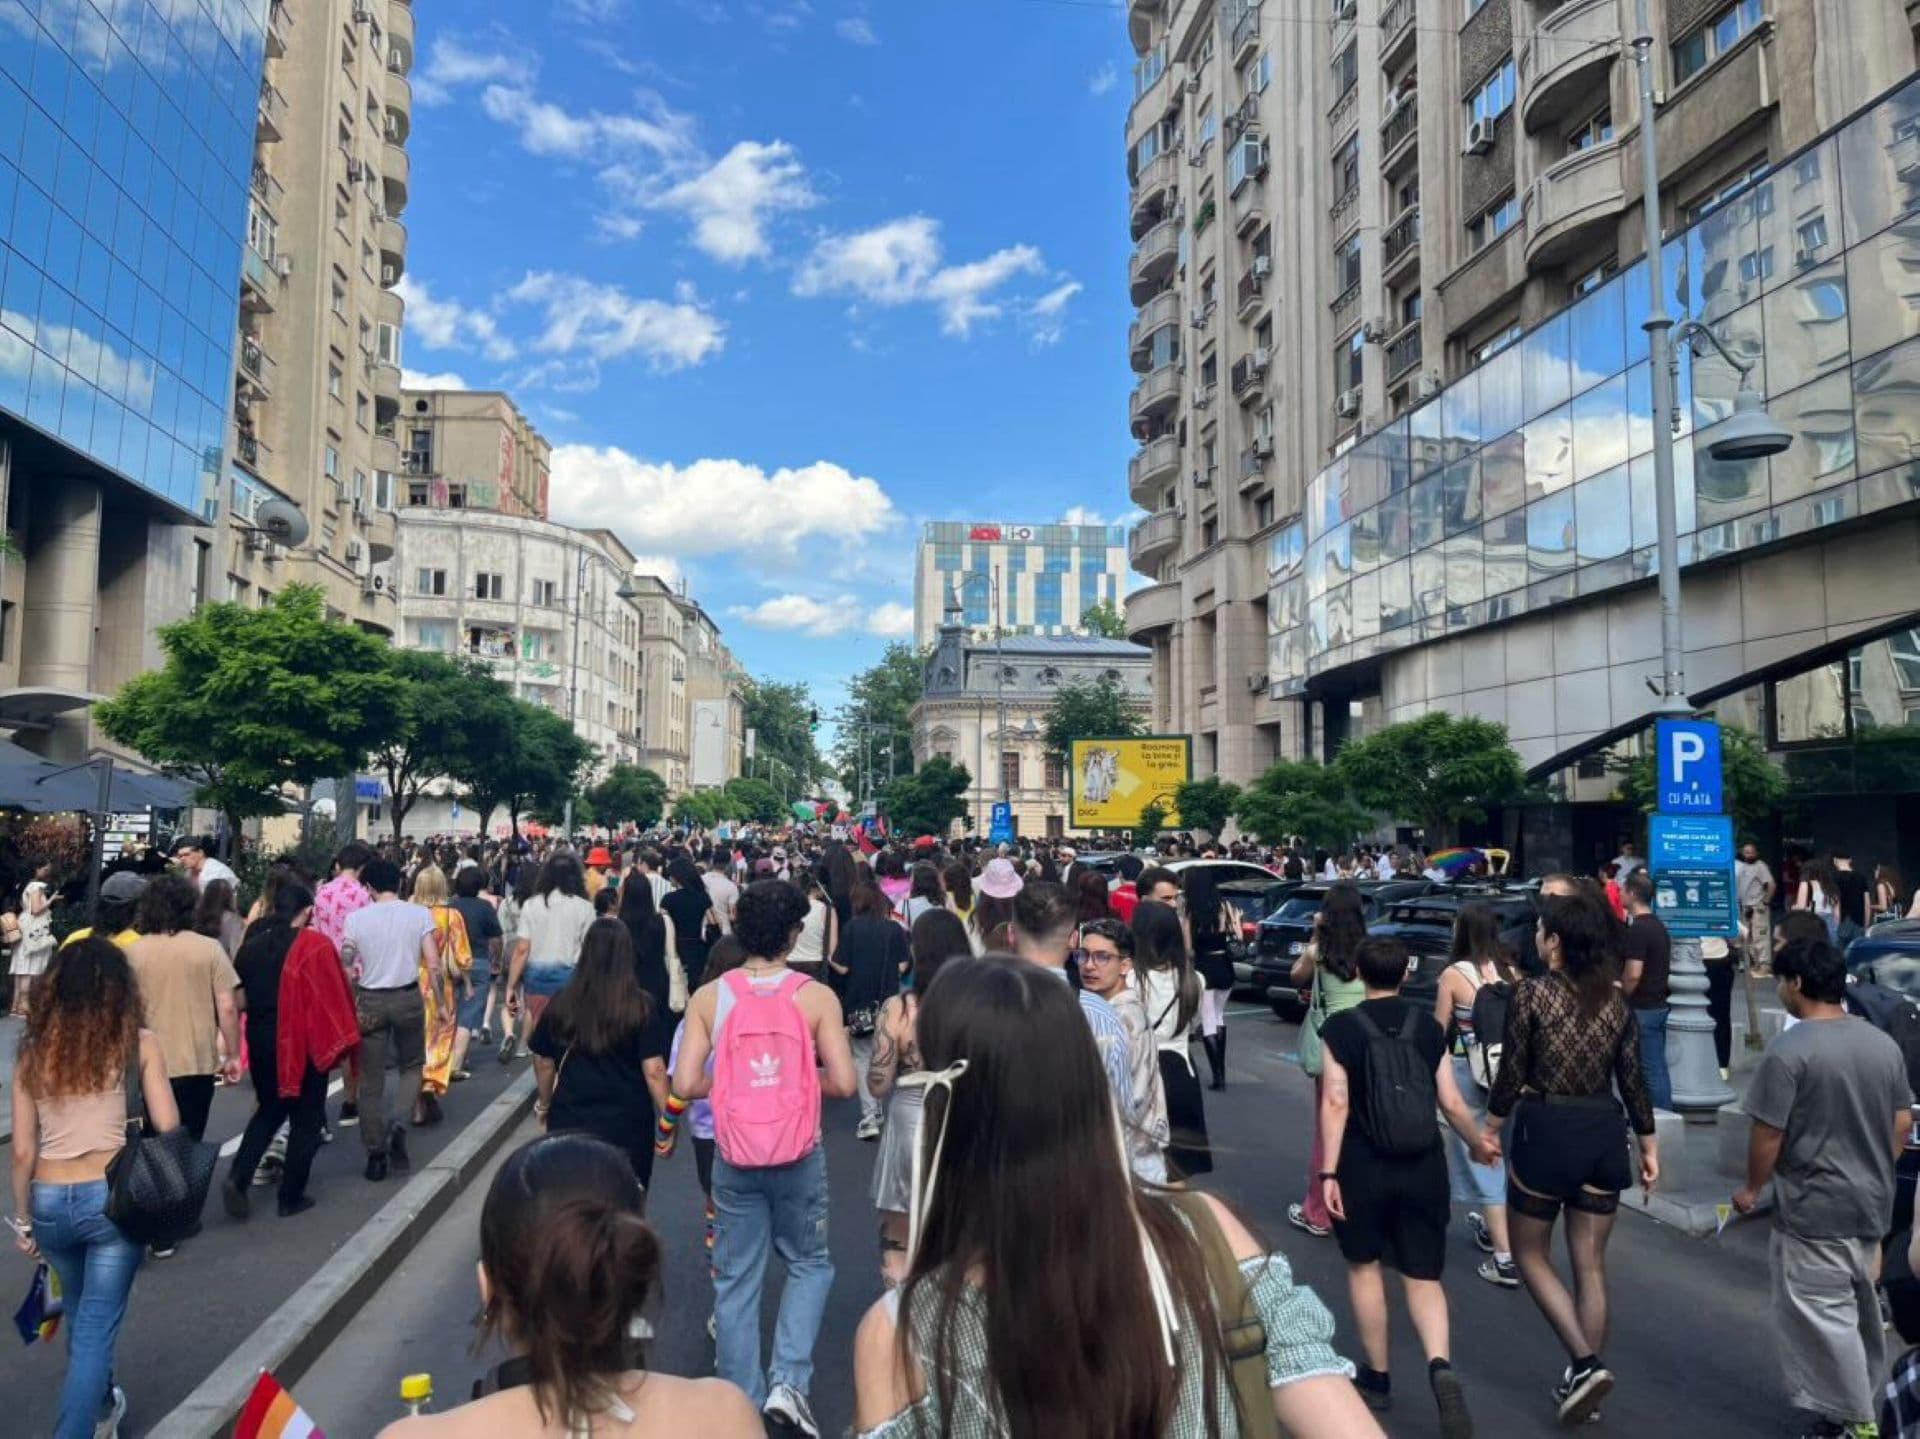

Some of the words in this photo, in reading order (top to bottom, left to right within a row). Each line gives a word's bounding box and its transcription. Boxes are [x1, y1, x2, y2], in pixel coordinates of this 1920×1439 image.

[1141, 743, 1181, 753] Roaming
[1672, 731, 1705, 783] P
[1146, 760, 1157, 769] la
[1668, 792, 1680, 804] CU
[995, 807, 1006, 821] P
